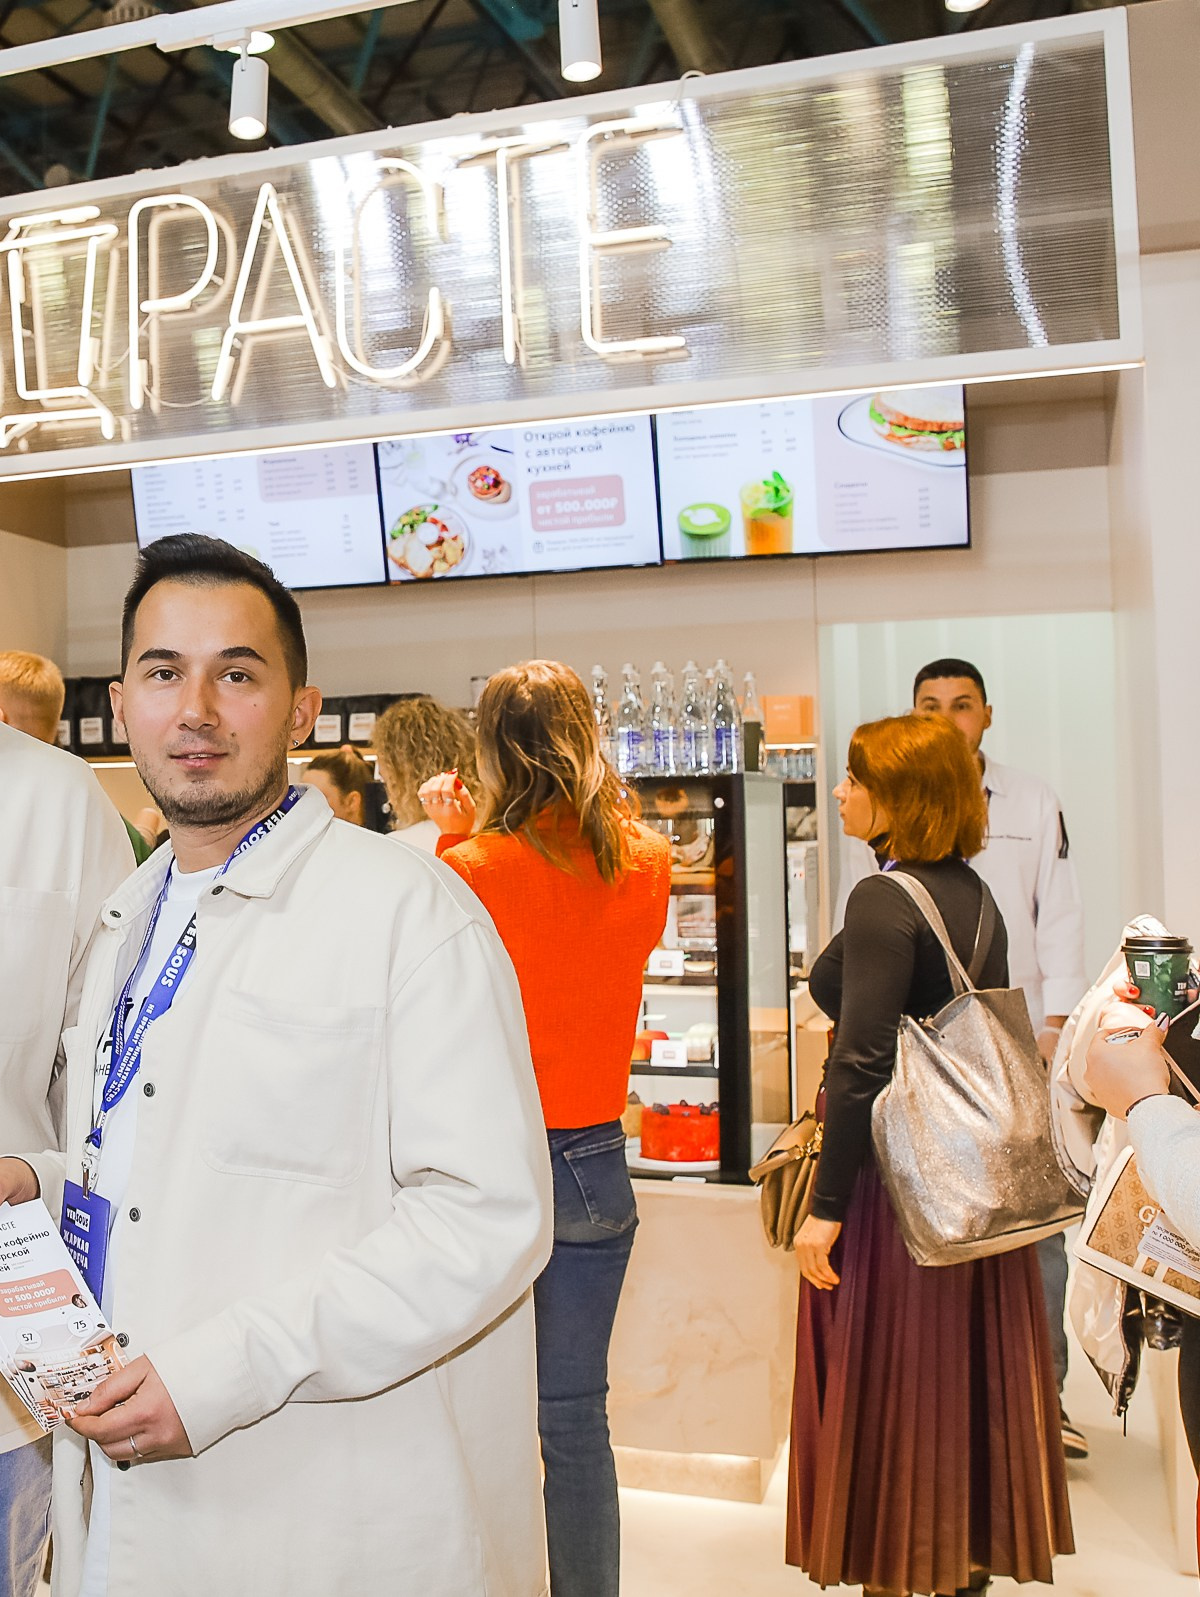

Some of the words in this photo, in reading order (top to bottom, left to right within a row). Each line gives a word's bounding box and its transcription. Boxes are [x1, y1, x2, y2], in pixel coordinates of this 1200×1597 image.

[4, 1230, 50, 1246] кофейню
[0, 1280, 46, 1294] зарабатывай
[8, 1302, 33, 1312] чистой
[34, 1294, 67, 1307] прибыли
[73, 1320, 87, 1330] 75
[21, 1333, 33, 1342] 57
